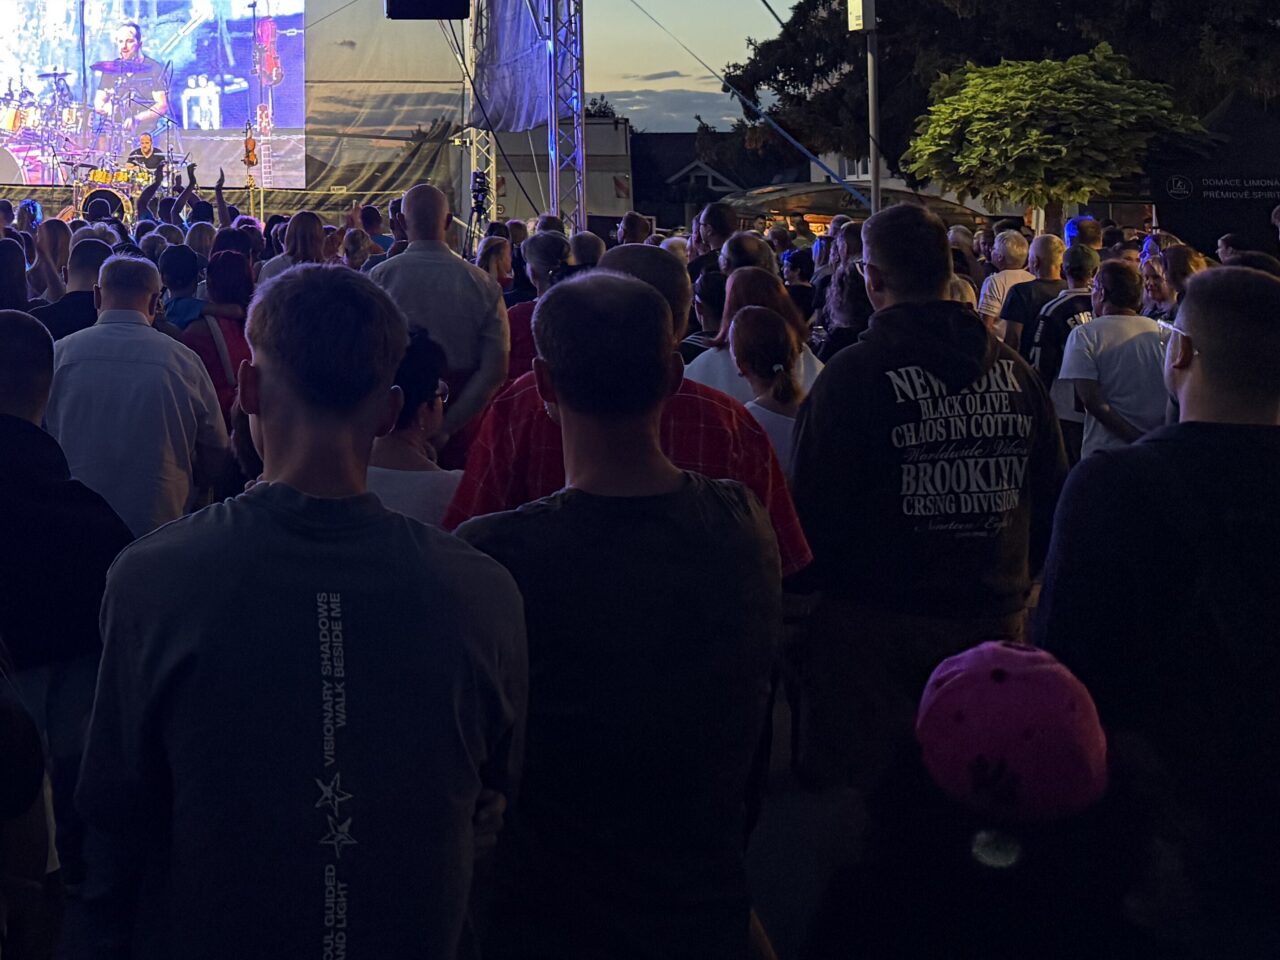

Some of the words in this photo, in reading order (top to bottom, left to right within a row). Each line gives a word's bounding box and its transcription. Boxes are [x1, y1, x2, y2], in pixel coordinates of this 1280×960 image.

[959, 359, 1023, 394] RK
[919, 394, 966, 421] BLACK
[965, 392, 1011, 415] OLIVE
[890, 418, 947, 448] CHAOS
[949, 415, 969, 440] IN
[900, 456, 1029, 496] BROOKLYN
[902, 494, 957, 516] CRSNG
[959, 489, 1020, 514] DIVISION
[329, 592, 343, 618] ME
[317, 592, 333, 676] SHADOWS
[331, 620, 345, 677] BESIDE
[322, 679, 336, 768] VISIONARY
[334, 681, 347, 728] WALK
[324, 864, 336, 927] GUIDED
[336, 879, 349, 928] LIGHT
